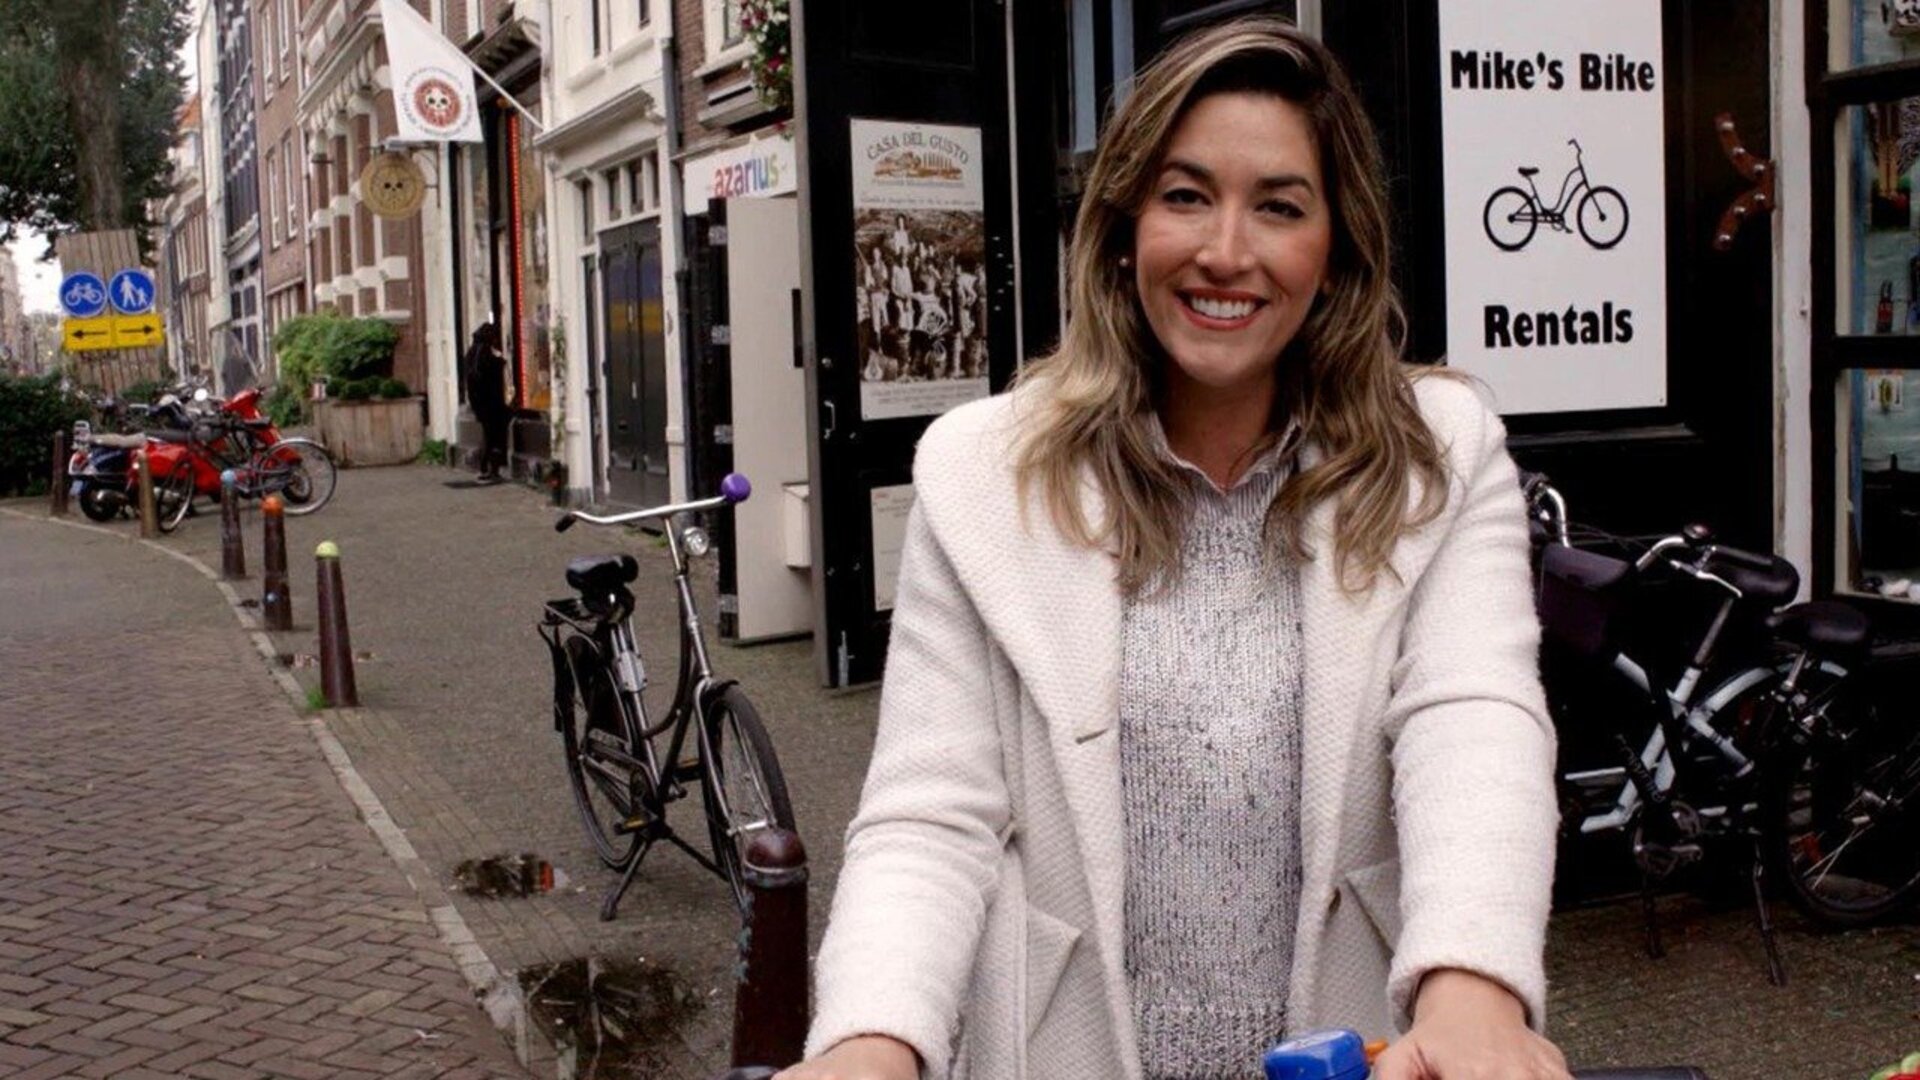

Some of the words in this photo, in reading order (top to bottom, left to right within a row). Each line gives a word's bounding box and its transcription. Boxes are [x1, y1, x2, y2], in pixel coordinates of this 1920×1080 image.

[1450, 50, 1564, 91] Mike's
[1579, 53, 1655, 91] Bike
[866, 135, 900, 160] CASA
[903, 131, 926, 147] DEL
[929, 134, 969, 165] GUSTO
[714, 153, 779, 197] azarius
[1484, 302, 1633, 348] Rentals
